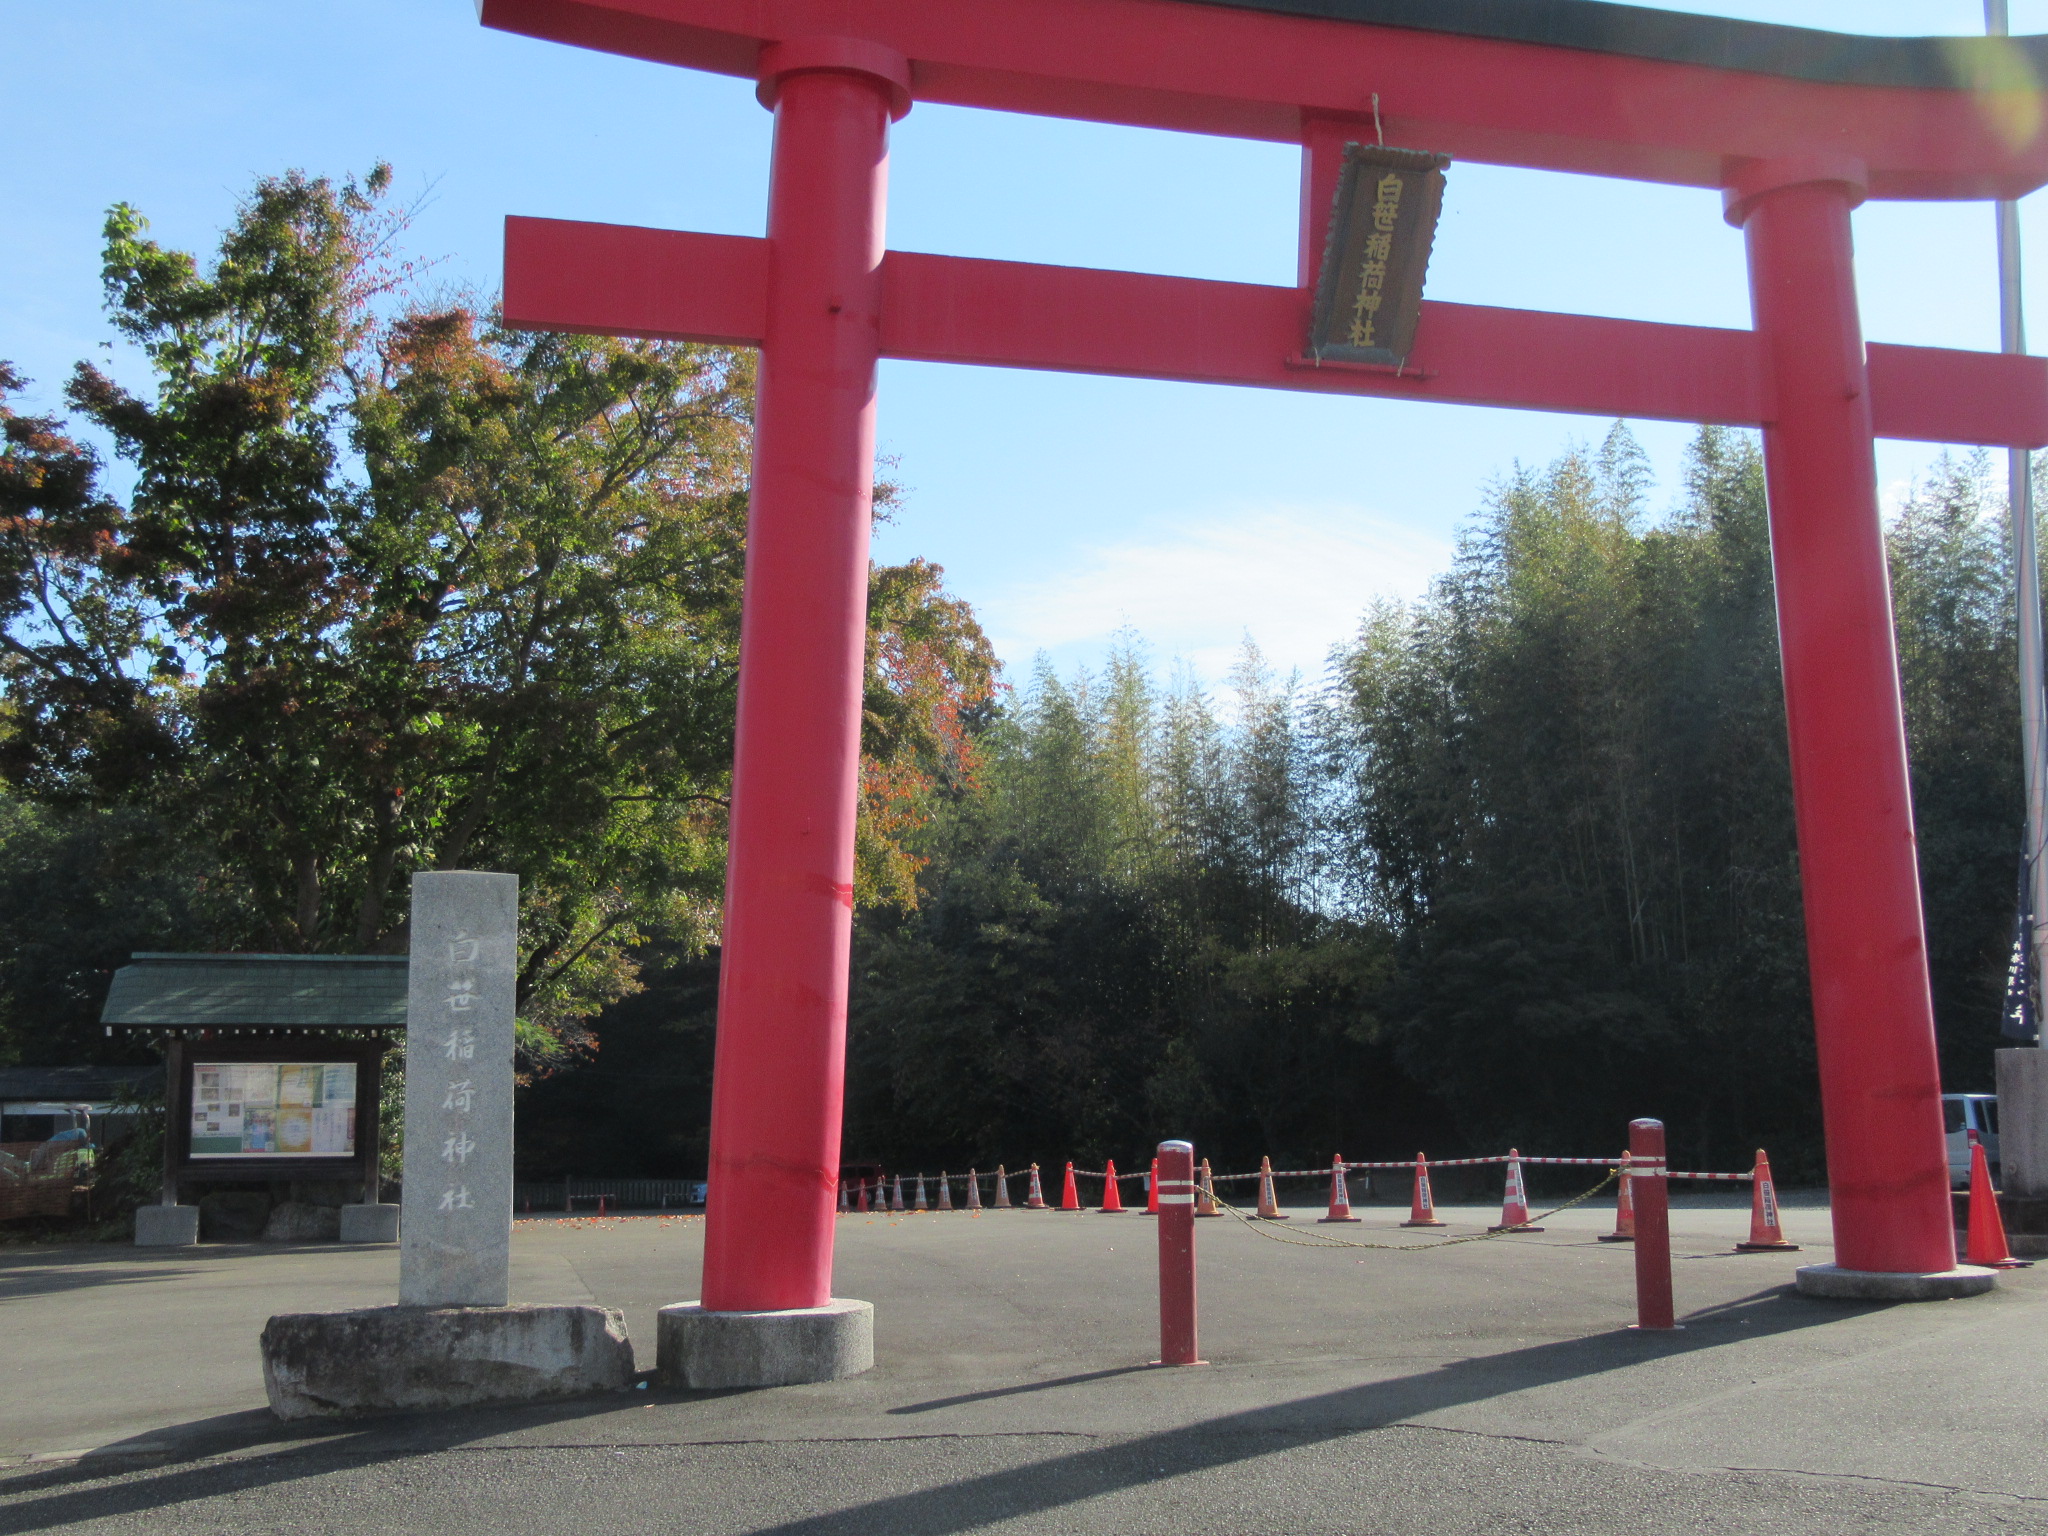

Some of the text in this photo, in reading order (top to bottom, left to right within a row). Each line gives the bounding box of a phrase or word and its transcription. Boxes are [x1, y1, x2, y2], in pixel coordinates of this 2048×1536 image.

[1349, 173, 1404, 348] 白笹稲荷神社
[438, 929, 482, 1211] 白笹稲荷神社
